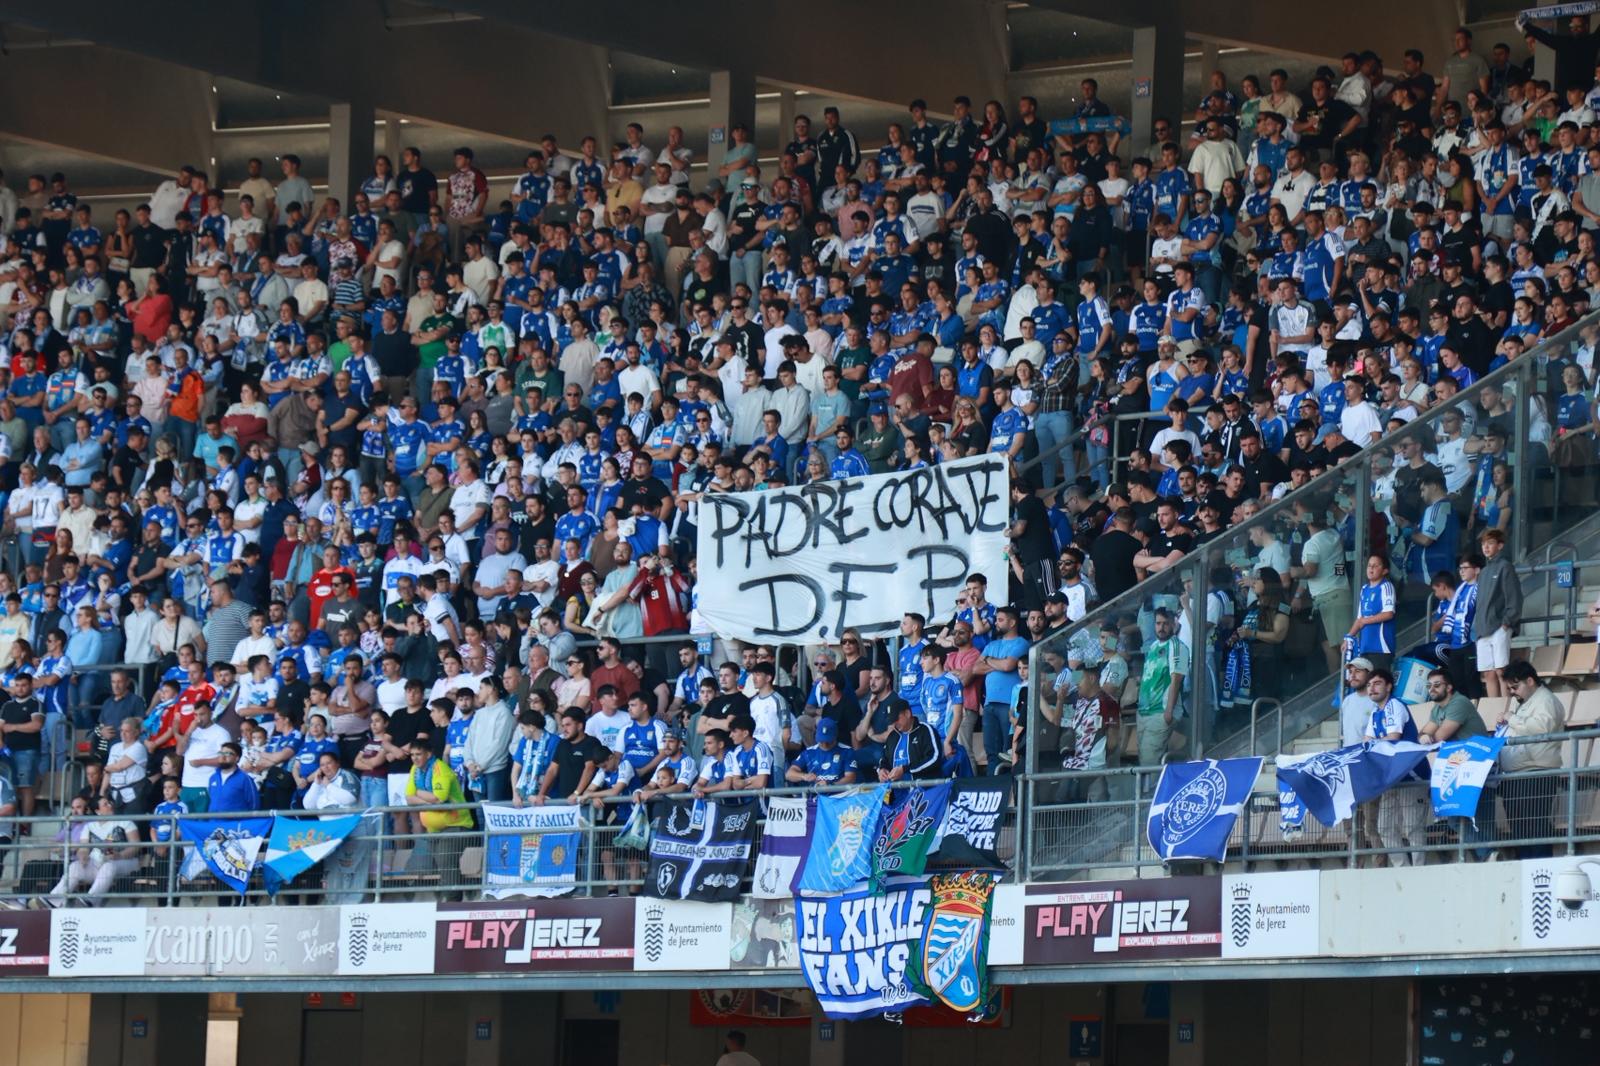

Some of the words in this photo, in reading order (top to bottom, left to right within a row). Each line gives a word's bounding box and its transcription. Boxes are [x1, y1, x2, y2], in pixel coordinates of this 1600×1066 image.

[703, 479, 869, 568] PADRE
[873, 460, 1007, 540] CORAJE
[1558, 572, 1571, 583] 210
[697, 642, 711, 652] 212
[535, 812, 576, 828] FAMILY
[1255, 902, 1311, 916] Ayuntamiento
[1556, 906, 1567, 919] de
[801, 902, 832, 952] EL
[840, 889, 932, 951] XIKLE
[1037, 904, 1108, 937] PLAY
[1093, 891, 1190, 952] JEREZ
[1255, 917, 1265, 929] de
[1266, 917, 1287, 931] Jerez
[372, 929, 427, 940] Ayuntamiento
[668, 922, 723, 936] Ayuntamiento
[83, 933, 137, 944] Ayuntamiento
[264, 923, 280, 962] SIN
[447, 920, 520, 950] PLAY
[505, 909, 602, 964] JEREZ
[668, 935, 678, 946] de
[678, 935, 699, 947] Jerez
[83, 946, 92, 955] de
[93, 946, 113, 957] Jerez
[372, 942, 381, 951] de
[382, 942, 403, 953] Jerez
[802, 943, 909, 996] FANS
